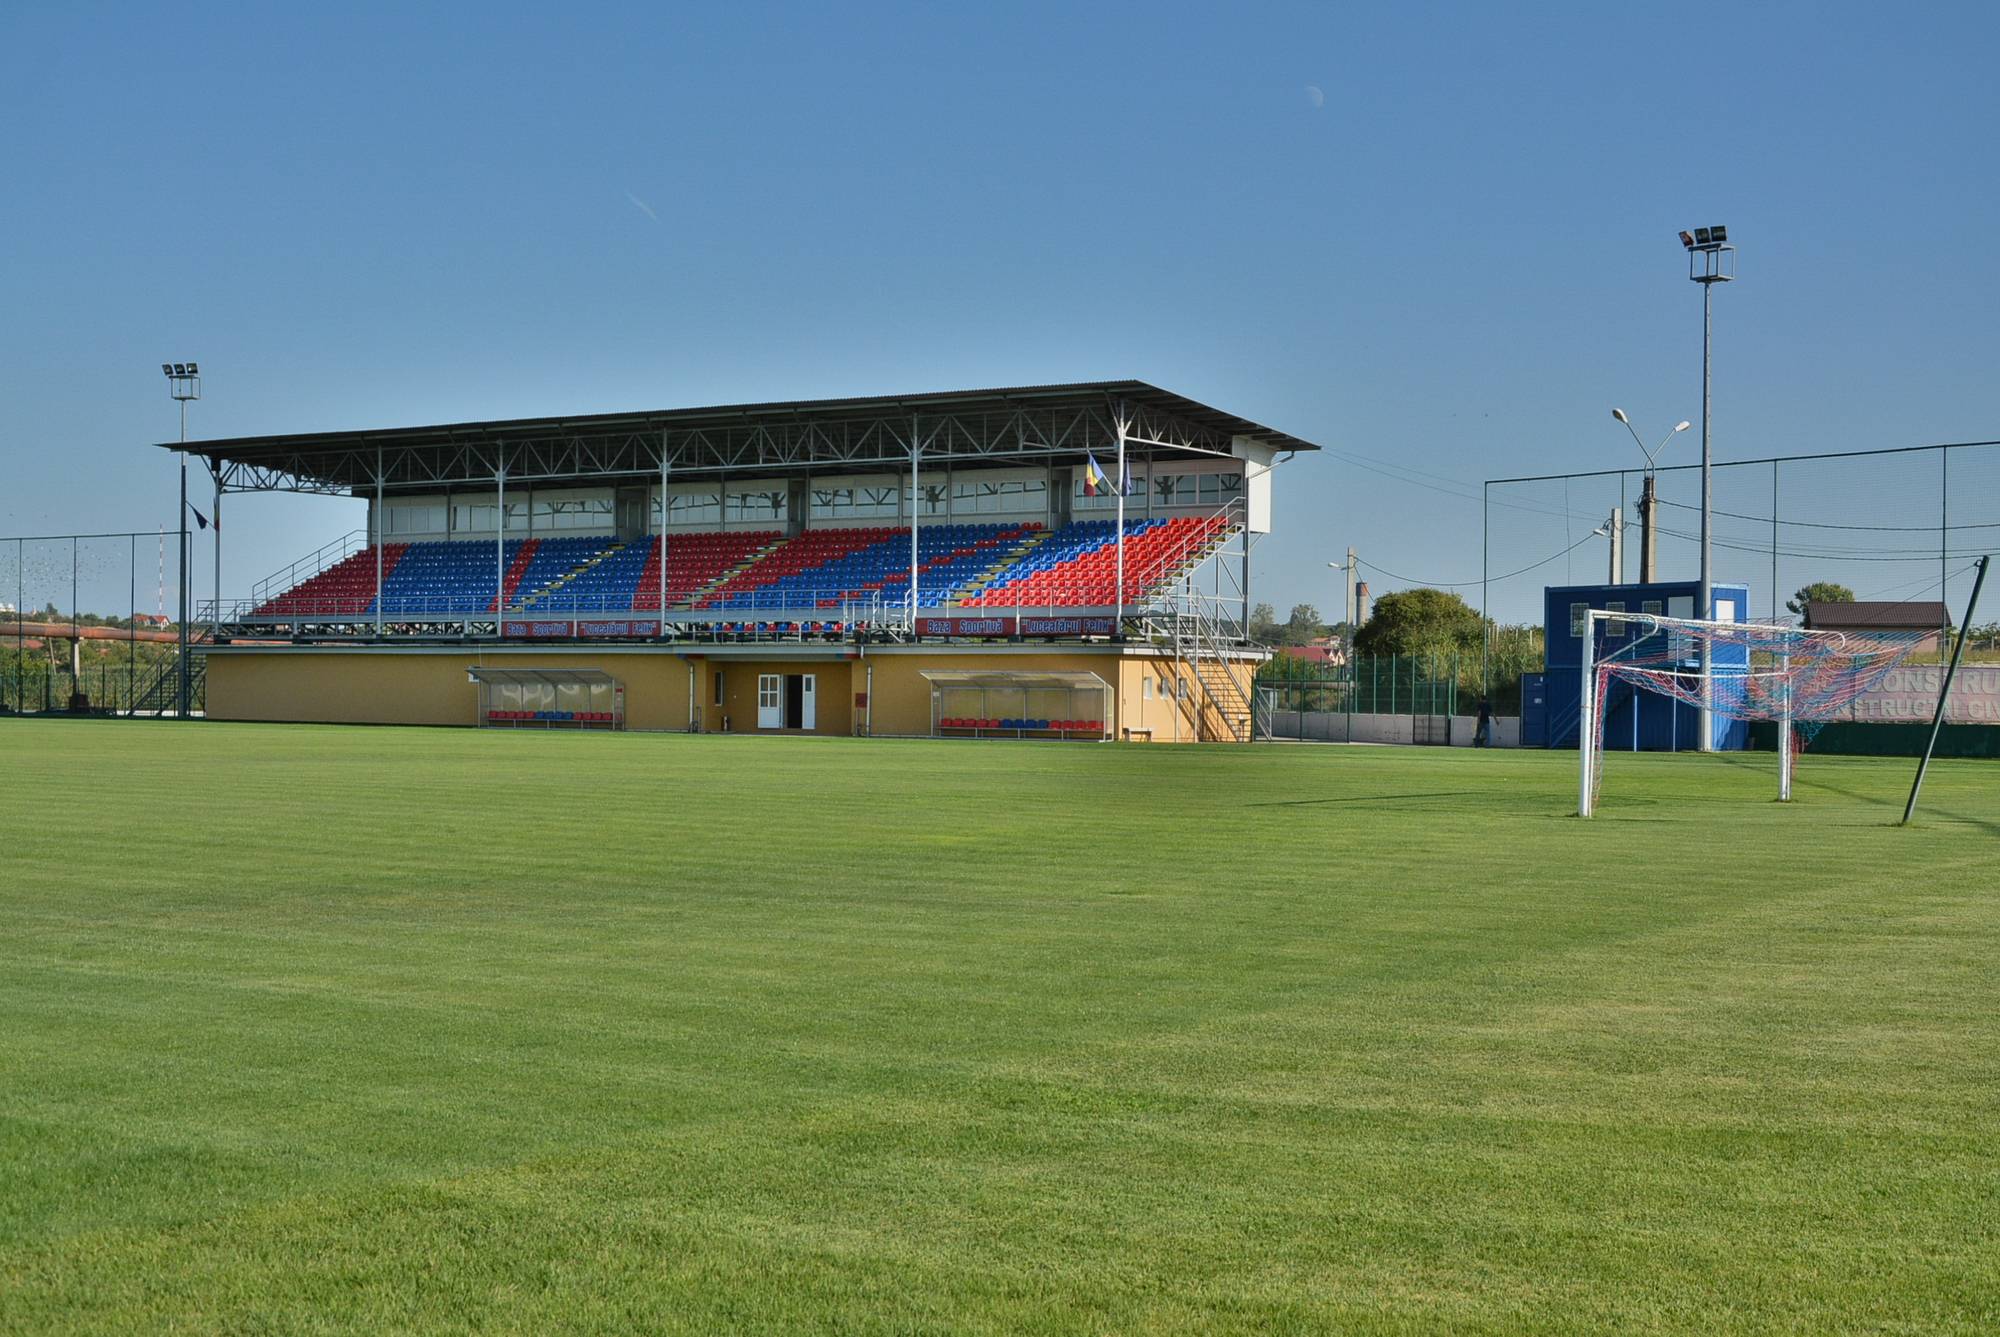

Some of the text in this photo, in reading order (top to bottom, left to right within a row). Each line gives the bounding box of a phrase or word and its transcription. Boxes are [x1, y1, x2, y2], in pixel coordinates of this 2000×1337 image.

[507, 622, 527, 635] Baza
[532, 622, 568, 636] Sportivă
[927, 619, 951, 633] Baza
[959, 618, 1003, 634] Sportivă
